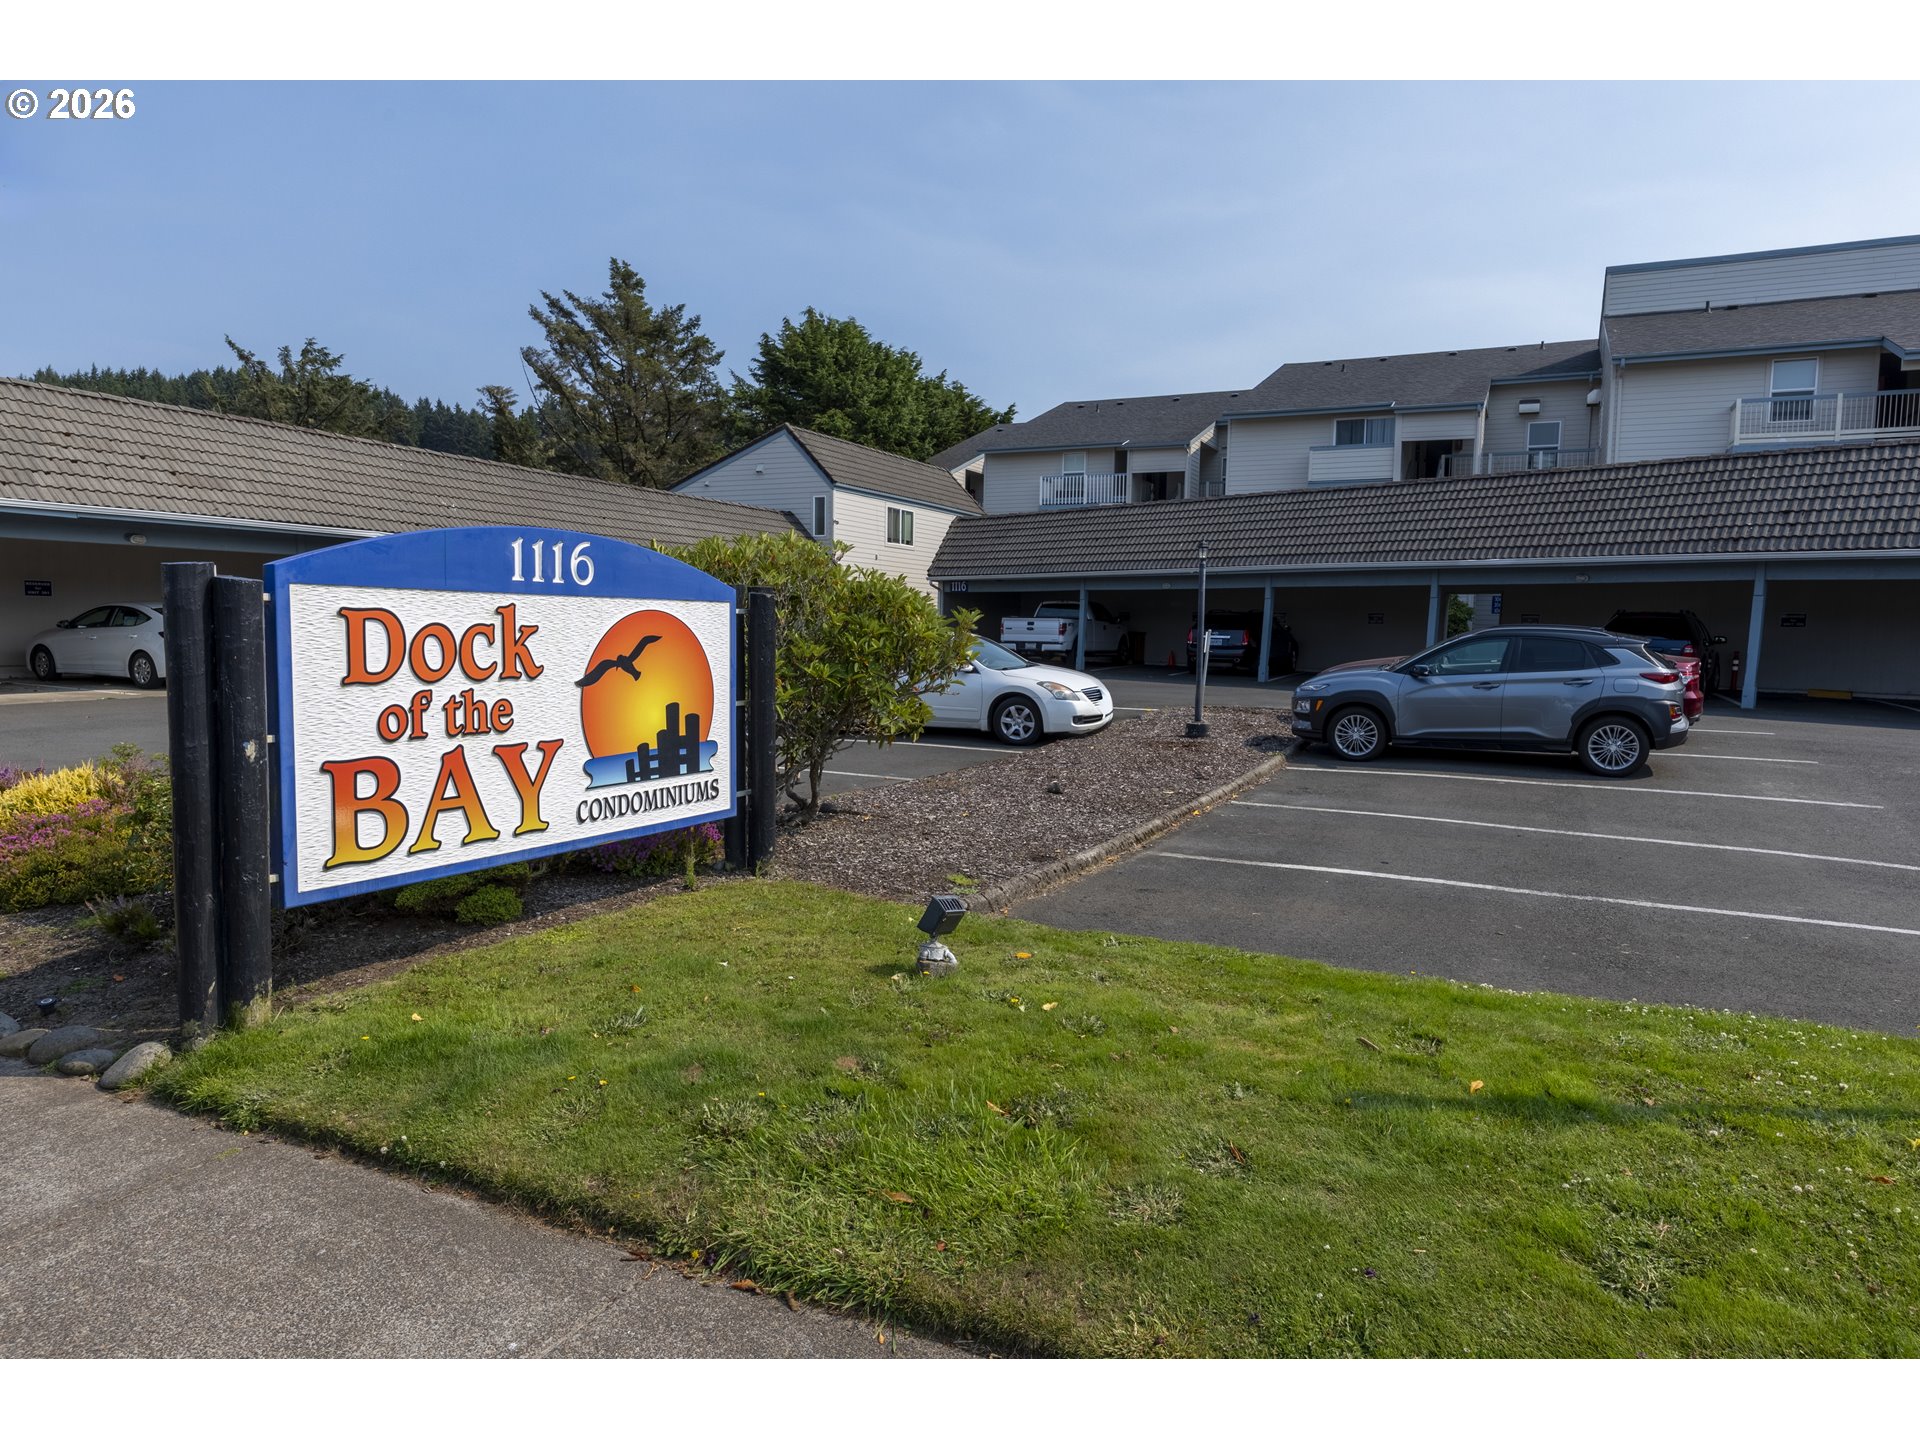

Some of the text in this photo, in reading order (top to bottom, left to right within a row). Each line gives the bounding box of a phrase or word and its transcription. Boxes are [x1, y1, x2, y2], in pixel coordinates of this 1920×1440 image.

[511, 536, 595, 586] 1116
[951, 581, 967, 591] 1116
[338, 603, 544, 687] Dock
[377, 688, 514, 742] of the
[320, 738, 564, 869] BAY
[575, 779, 719, 824] CONDOMINIUMS
